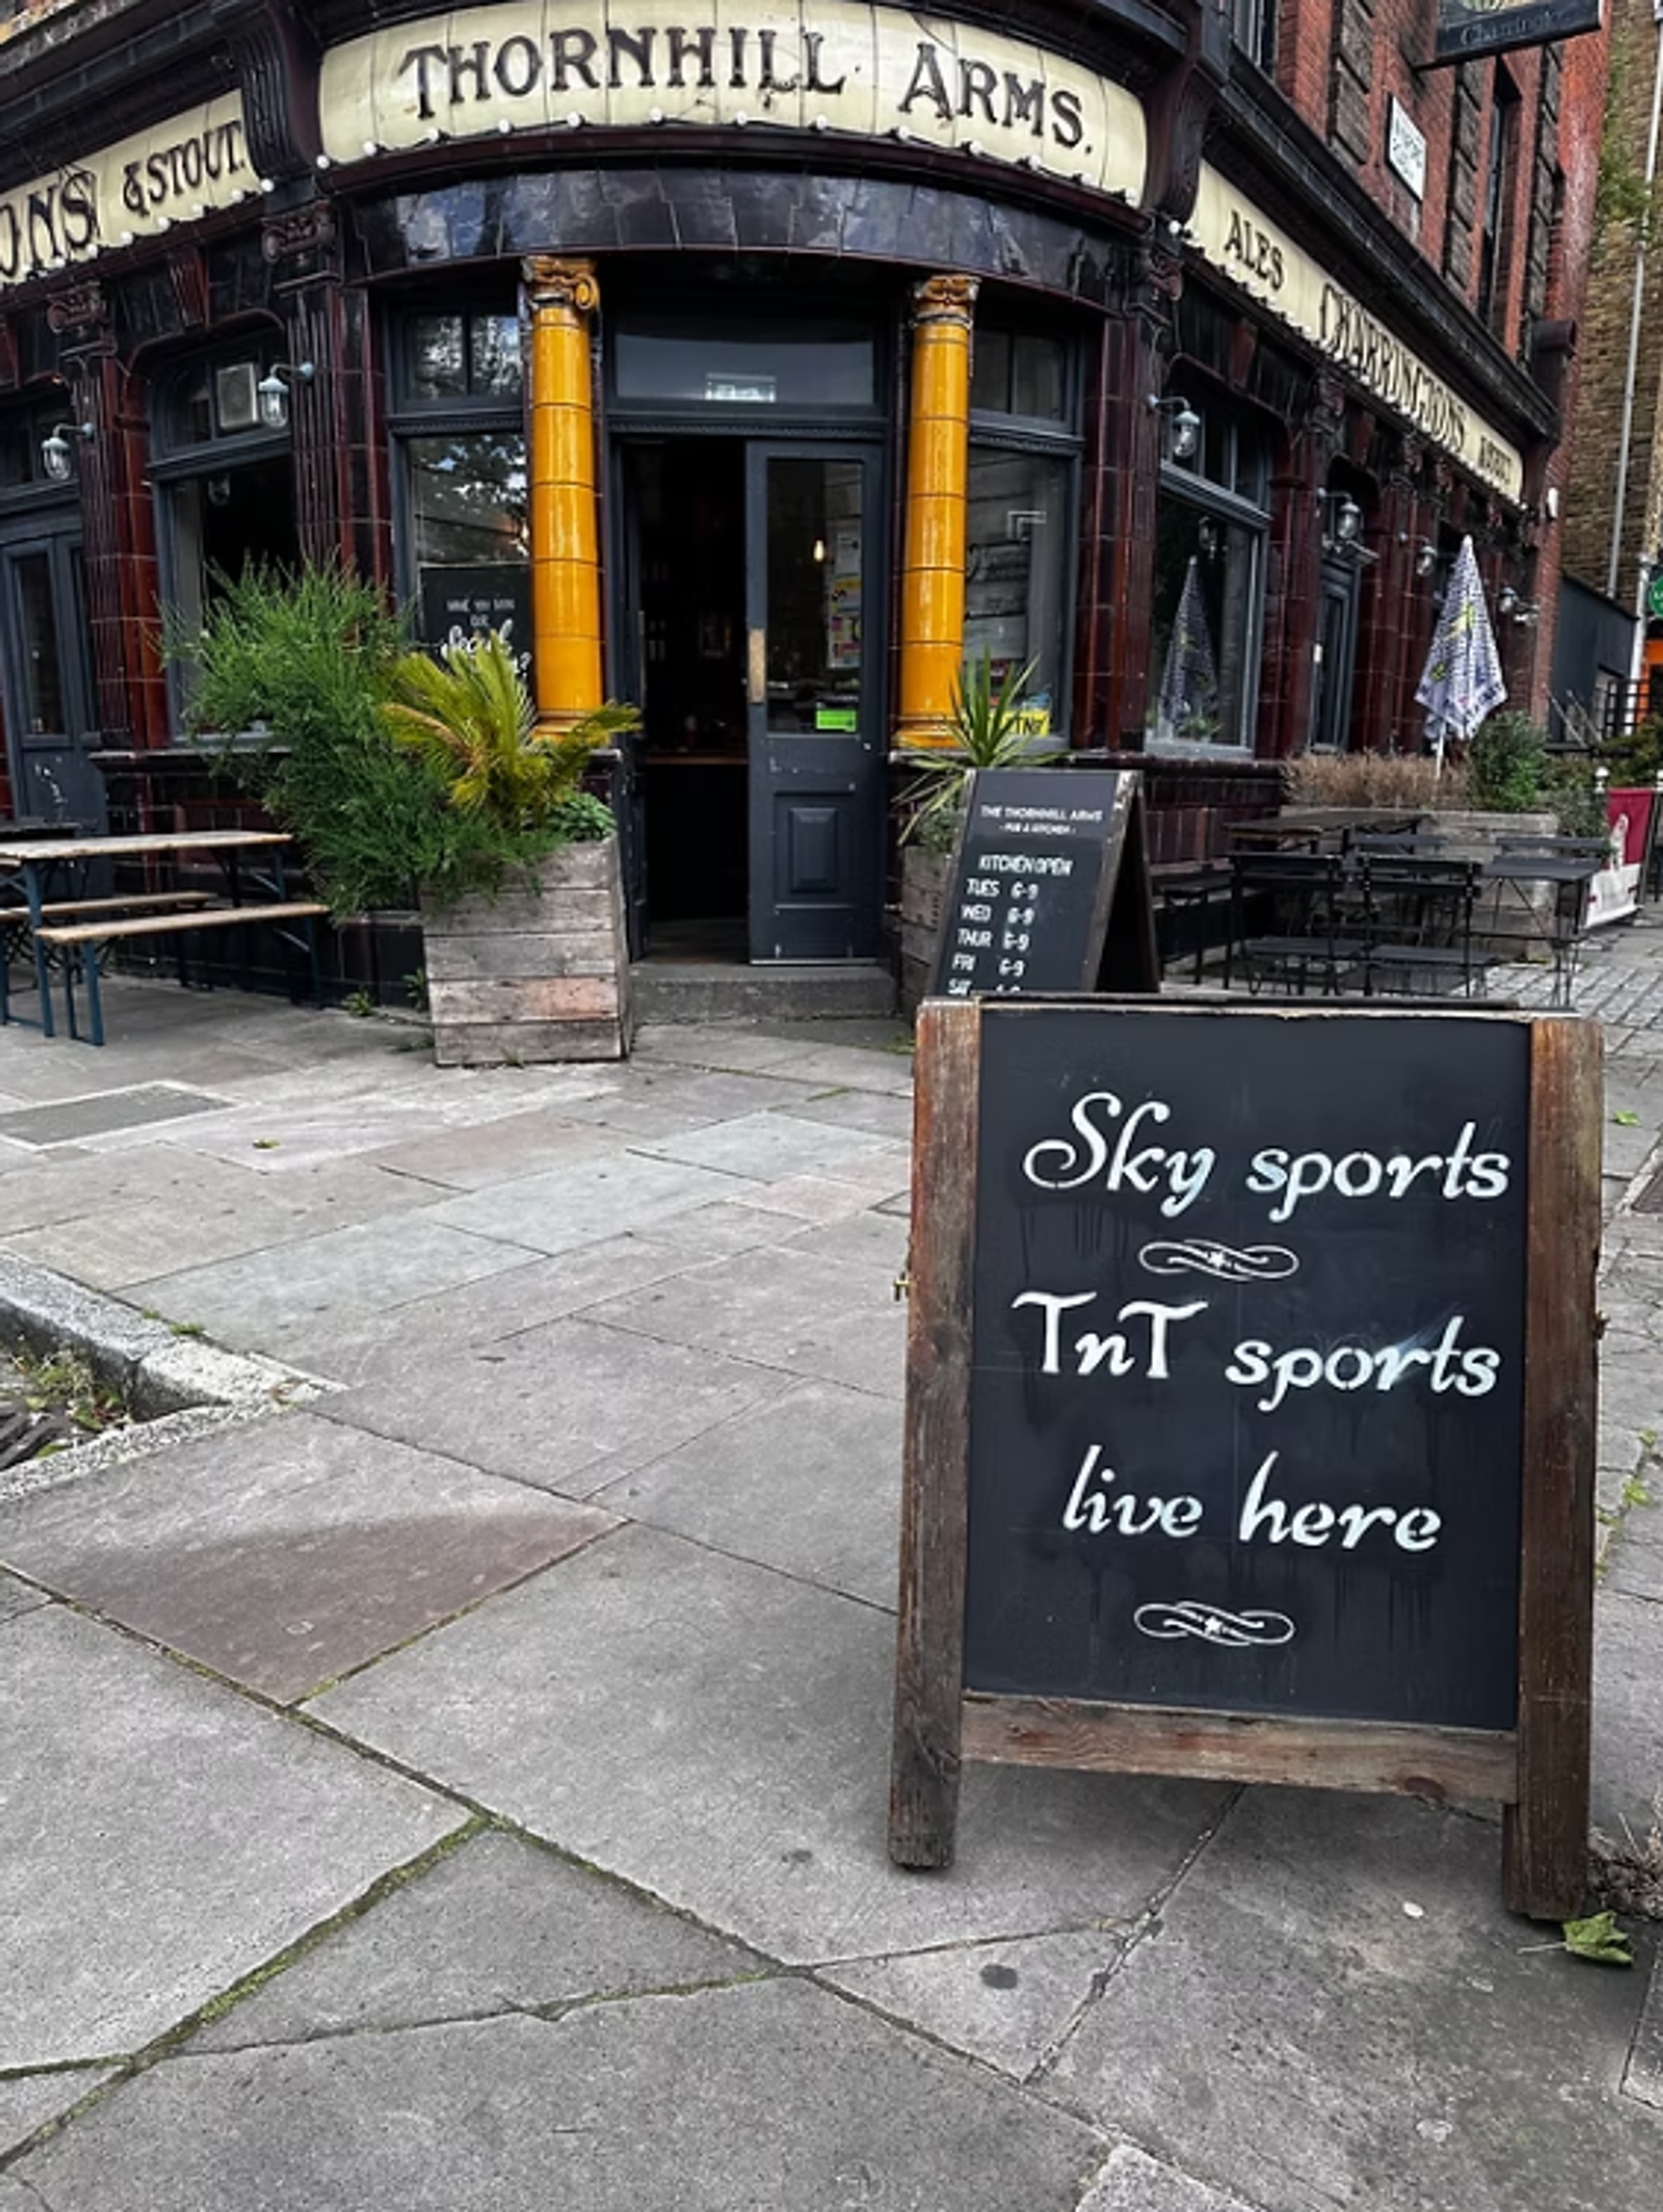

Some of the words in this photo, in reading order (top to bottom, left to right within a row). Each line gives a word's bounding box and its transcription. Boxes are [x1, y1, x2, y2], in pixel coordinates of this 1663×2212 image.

[398, 26, 846, 120] THORNHILL
[897, 41, 1093, 155] ARMS.
[1224, 209, 1284, 292] ALES
[980, 804, 1003, 818] THE
[1069, 810, 1103, 823] ARMS
[978, 855, 1032, 874] KITCHEN
[1034, 857, 1074, 876] OPEN
[966, 877, 1000, 898] TUES
[1010, 881, 1039, 901] 6-9
[961, 904, 992, 924] WED
[1007, 907, 1035, 926] 6-9
[957, 928, 993, 948] THUR
[951, 953, 977, 972] FRI
[999, 958, 1026, 977] 6-9
[1022, 1091, 1216, 1217] Sky
[1245, 1121, 1511, 1223] sports
[1012, 1291, 1209, 1379] TnT
[1225, 1316, 1501, 1412] sports
[1062, 1445, 1204, 1537] live
[1239, 1451, 1442, 1551] here
